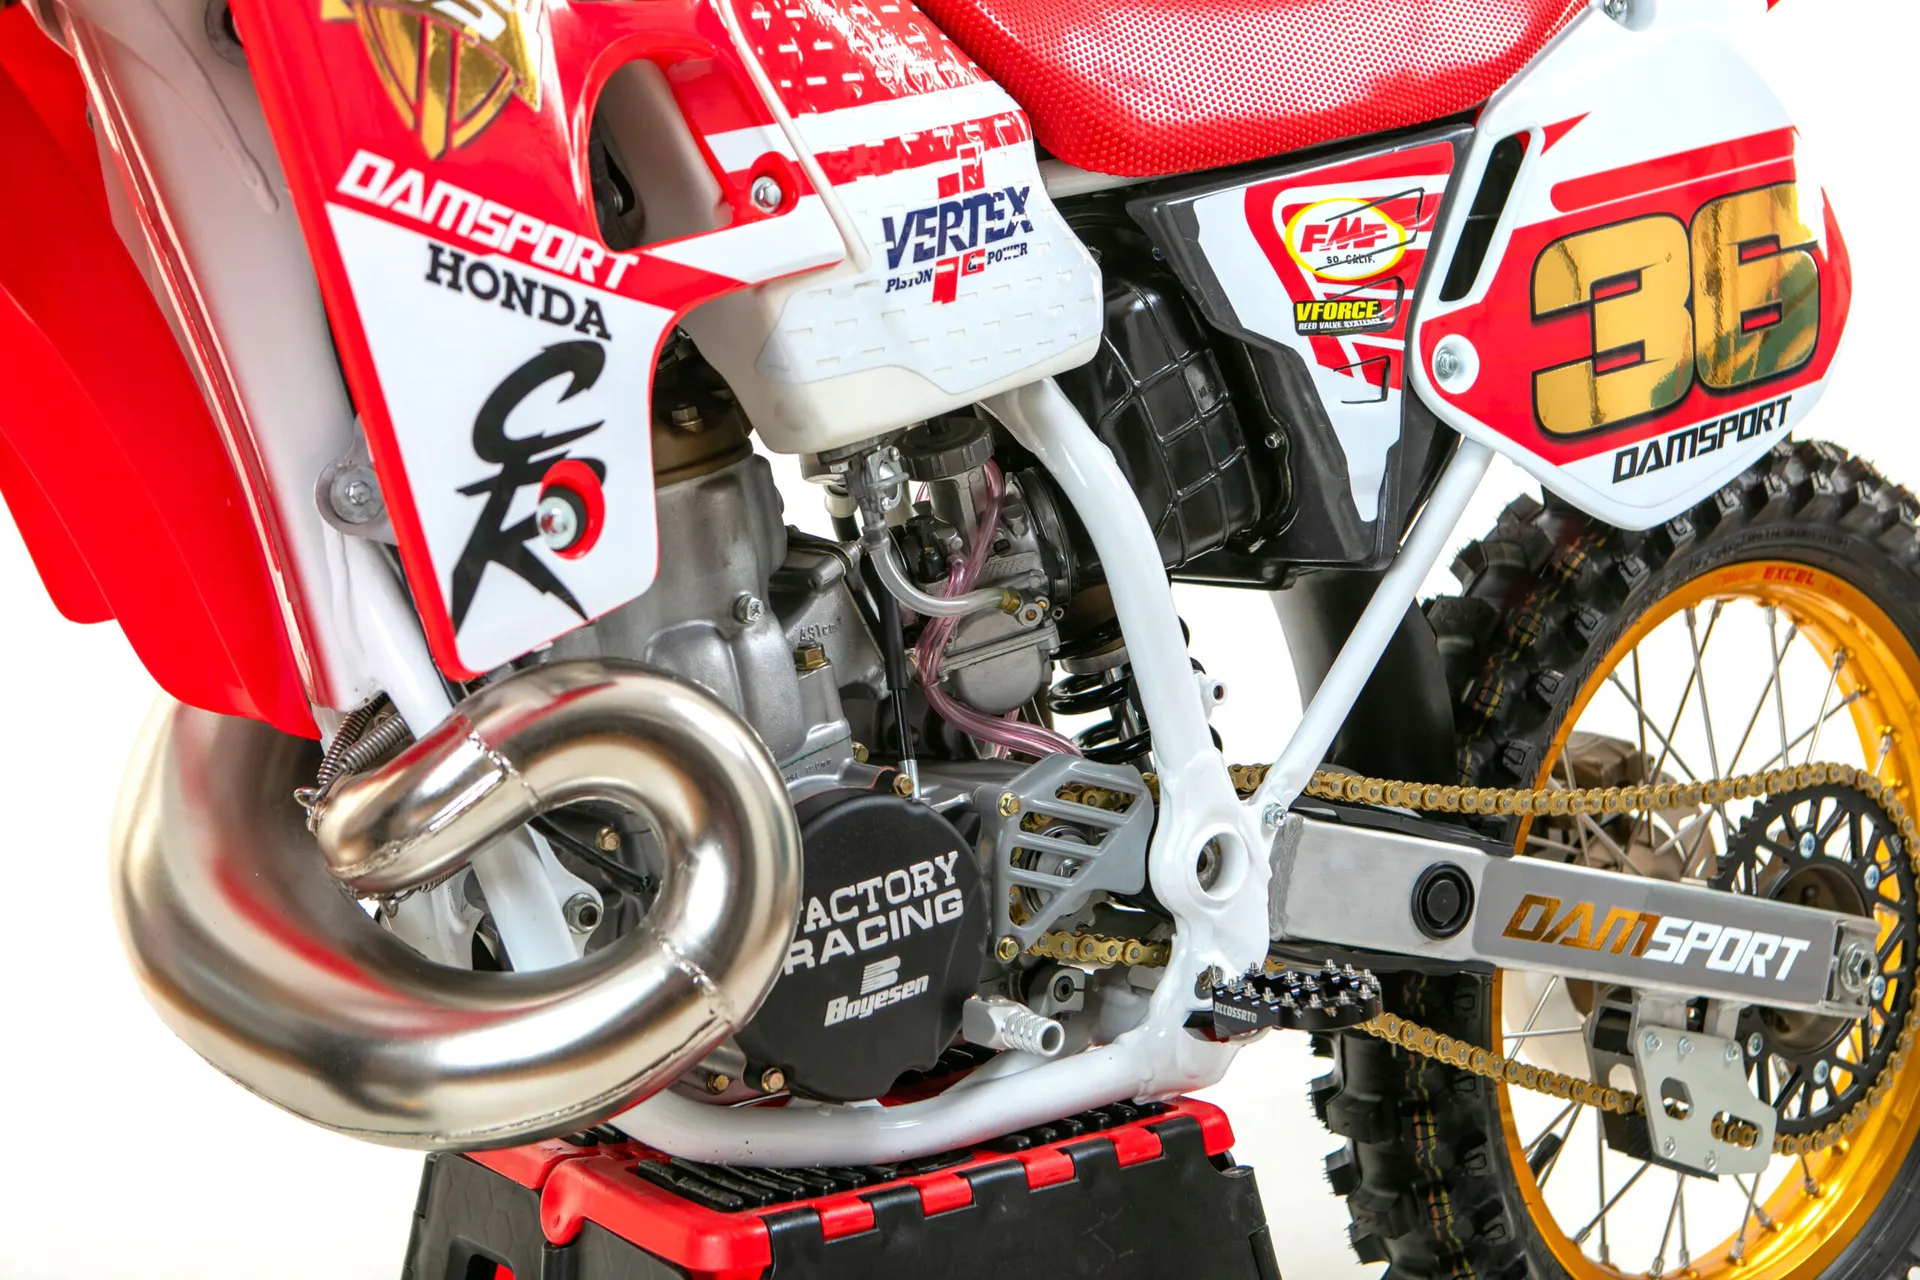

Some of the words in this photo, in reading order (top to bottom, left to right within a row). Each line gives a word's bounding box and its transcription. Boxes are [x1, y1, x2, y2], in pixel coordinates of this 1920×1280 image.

[337, 148, 640, 290] DAMSPORT
[882, 186, 1034, 270] VERTEX
[1300, 216, 1388, 252] FMF
[424, 242, 612, 341] HONDA
[885, 268, 933, 293] PISTON
[1296, 300, 1379, 321] VFORCE
[1530, 180, 1822, 446] 36
[1298, 322, 1318, 331] REED
[1319, 319, 1343, 330] VALVE
[1612, 396, 1792, 484] DAMSPORT
[1762, 565, 1816, 585] EXCEL
[784, 888, 964, 976] RACING
[799, 850, 958, 933] ACTORY
[1502, 893, 1811, 982] DAMSPORT
[824, 975, 930, 1027] Boyesen
